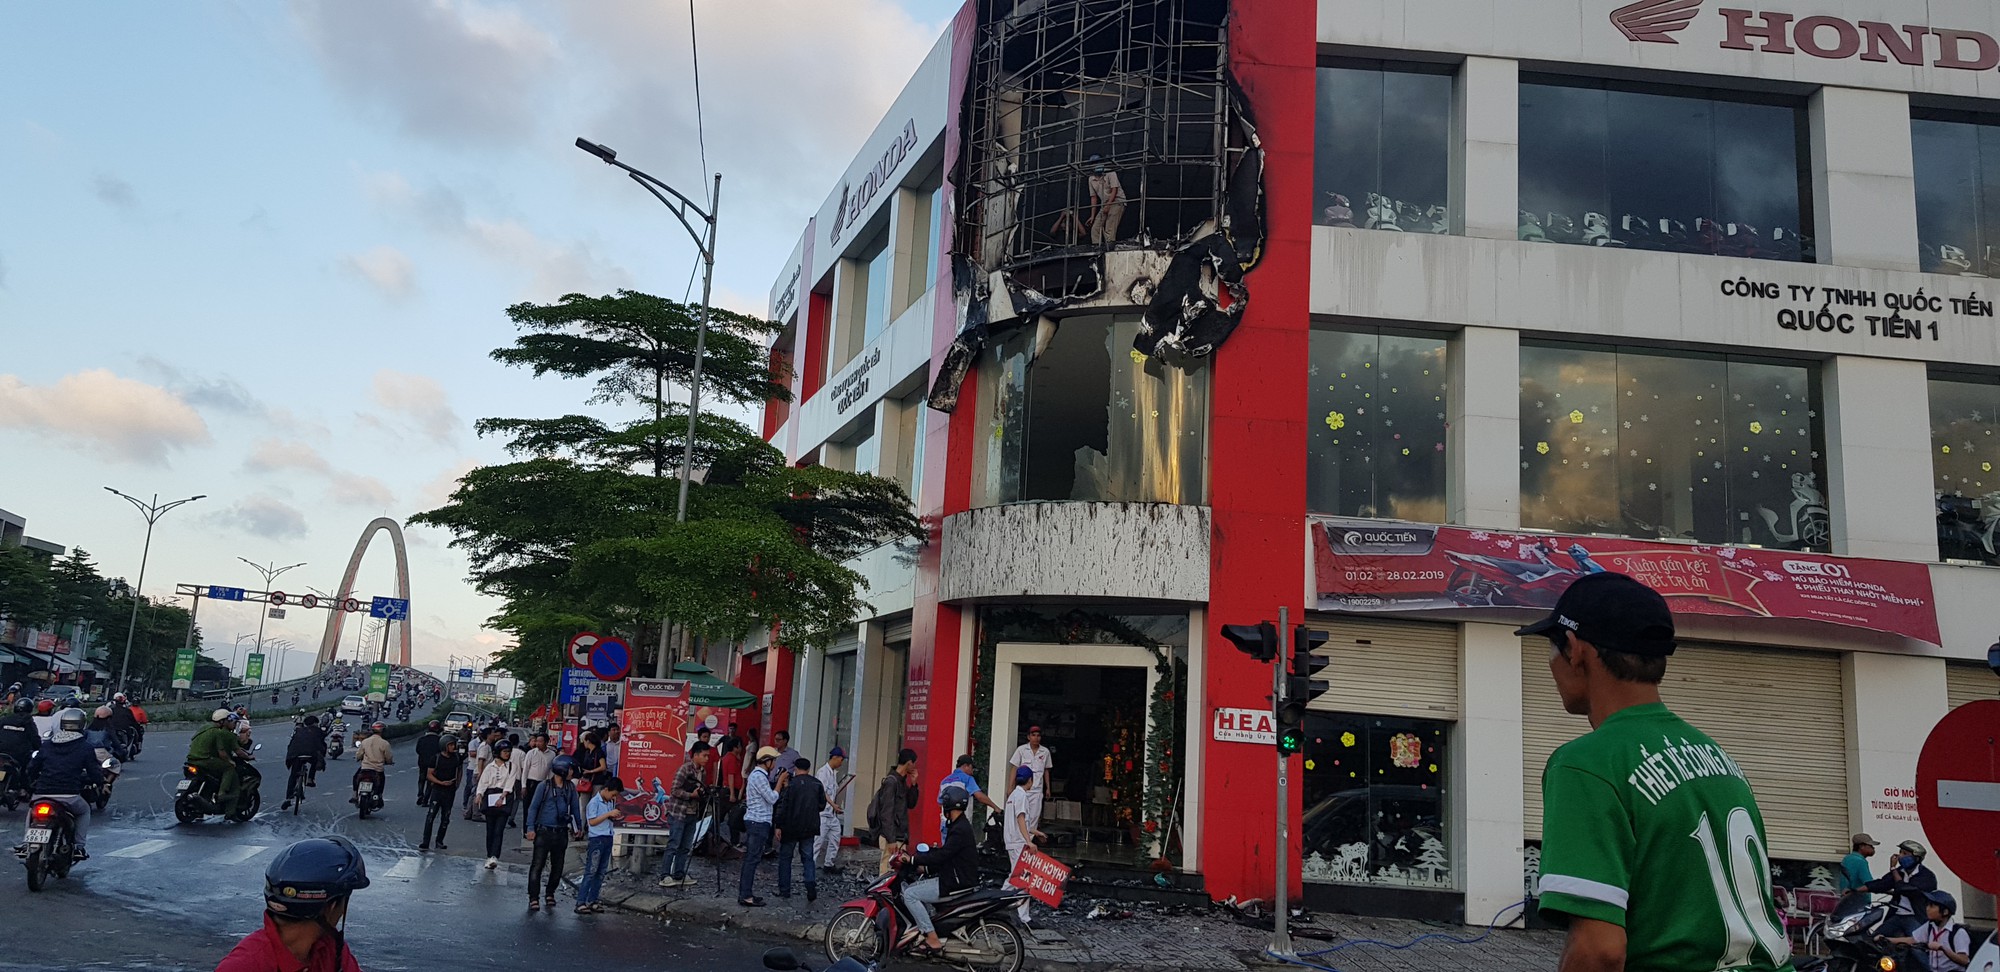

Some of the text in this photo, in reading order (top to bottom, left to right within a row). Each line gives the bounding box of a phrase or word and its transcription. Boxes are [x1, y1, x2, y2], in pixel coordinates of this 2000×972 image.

[1719, 8, 2000, 71] HOND
[846, 117, 917, 230] HONDA
[1720, 276, 1994, 318] CÔNG TY TNHH QUỐC TIẾN
[1777, 303, 1939, 341] QUỐC TIẾN 1
[1364, 532, 1417, 543] QUỐC TIẾN
[1345, 571, 1374, 581] 01.02
[1386, 570, 1445, 580] 28.02.2019
[1613, 558, 1662, 573] Xuân
[1823, 563, 1852, 579] 01
[1790, 575, 1807, 583] MŨ
[1808, 575, 1828, 585] BẢO
[1853, 581, 1887, 593] HONDA
[1831, 586, 1855, 596] THAY
[1680, 737, 1728, 778] CÔNG
[1689, 806, 1791, 970] 10
